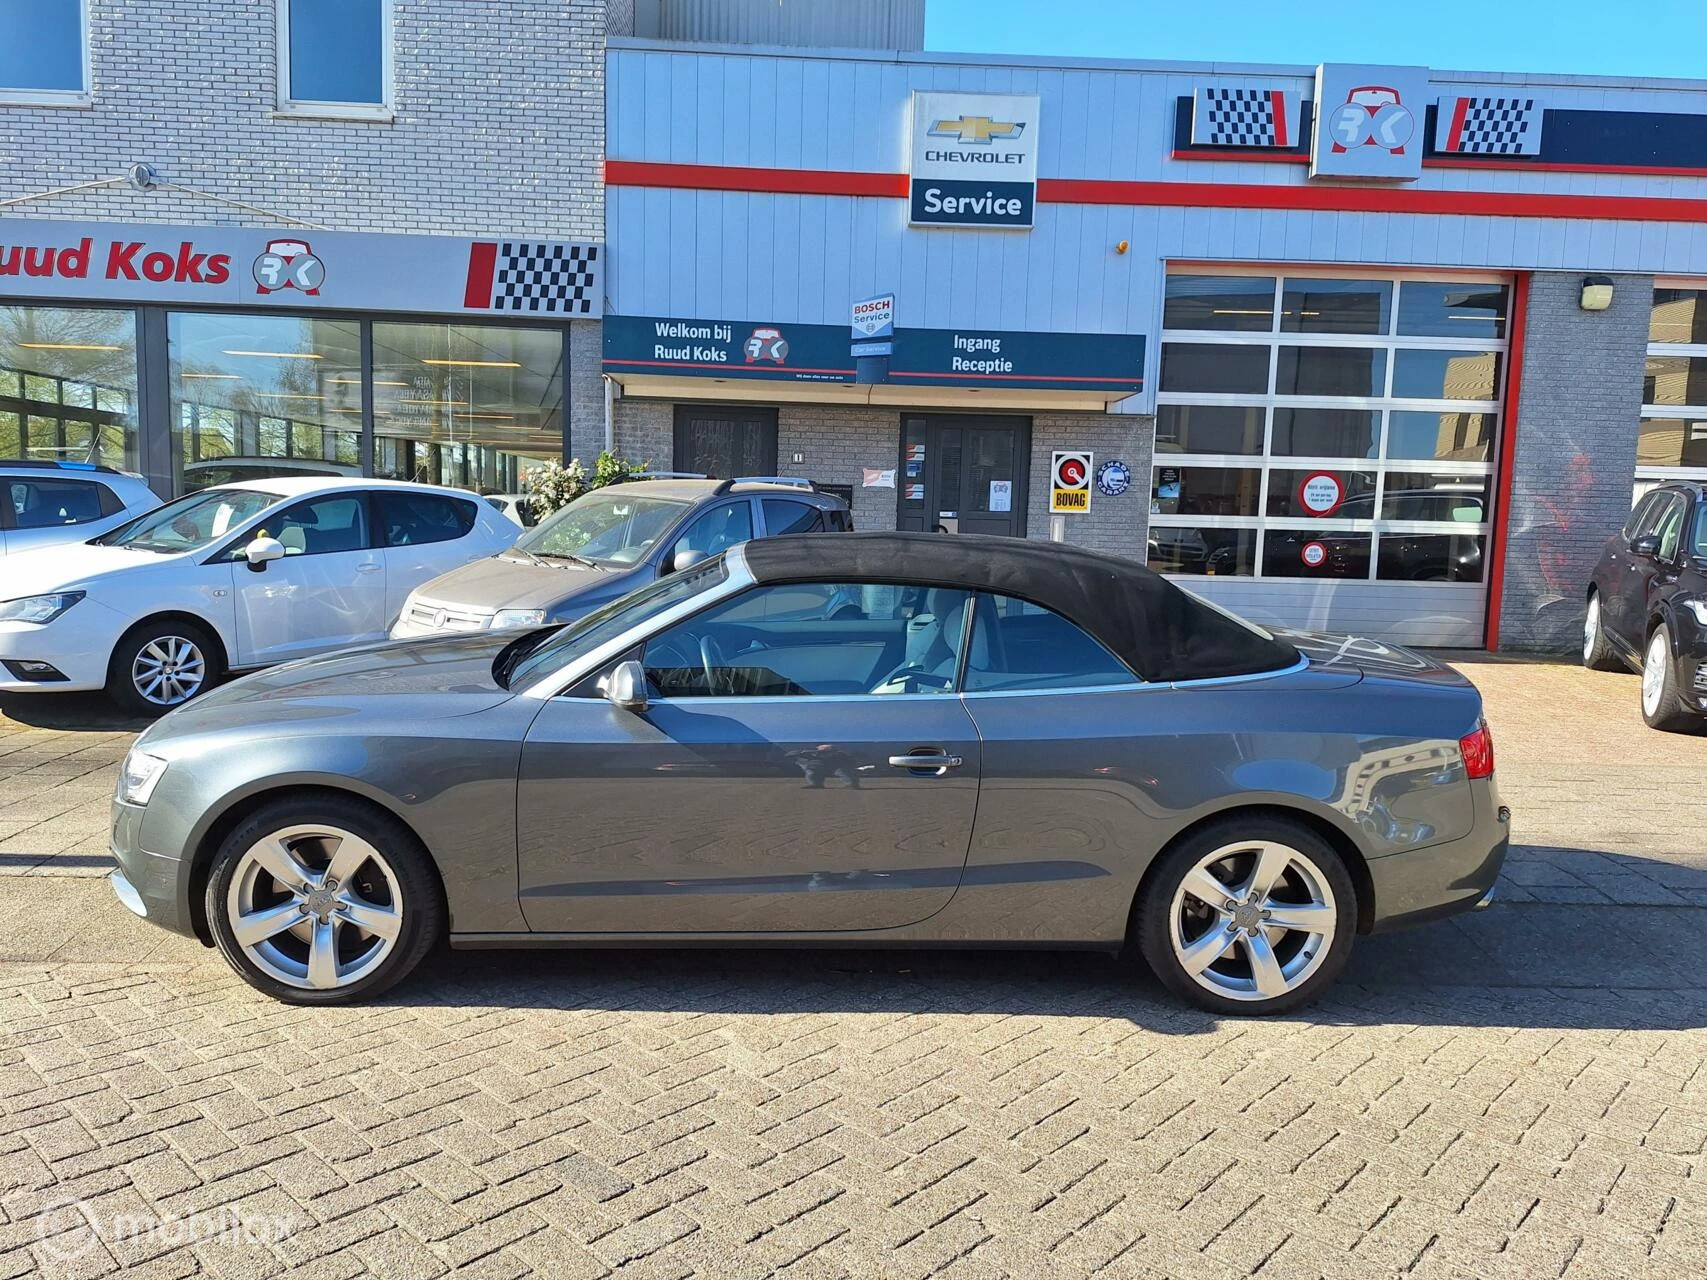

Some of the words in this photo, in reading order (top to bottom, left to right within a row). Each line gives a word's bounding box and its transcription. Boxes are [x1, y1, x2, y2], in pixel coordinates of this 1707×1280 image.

[925, 150, 1025, 164] CHEVROLET
[924, 188, 1022, 215] Service
[105, 241, 231, 284] Koks
[854, 300, 890, 314] BOSCH
[854, 312, 890, 323] Service
[655, 322, 711, 339] Welkom
[714, 324, 732, 343] bij
[953, 334, 1001, 353] Ingang
[654, 344, 690, 360] Ruud
[693, 346, 727, 362] Koks
[952, 356, 1013, 374] Receptie
[1056, 492, 1086, 506] BOVAG
